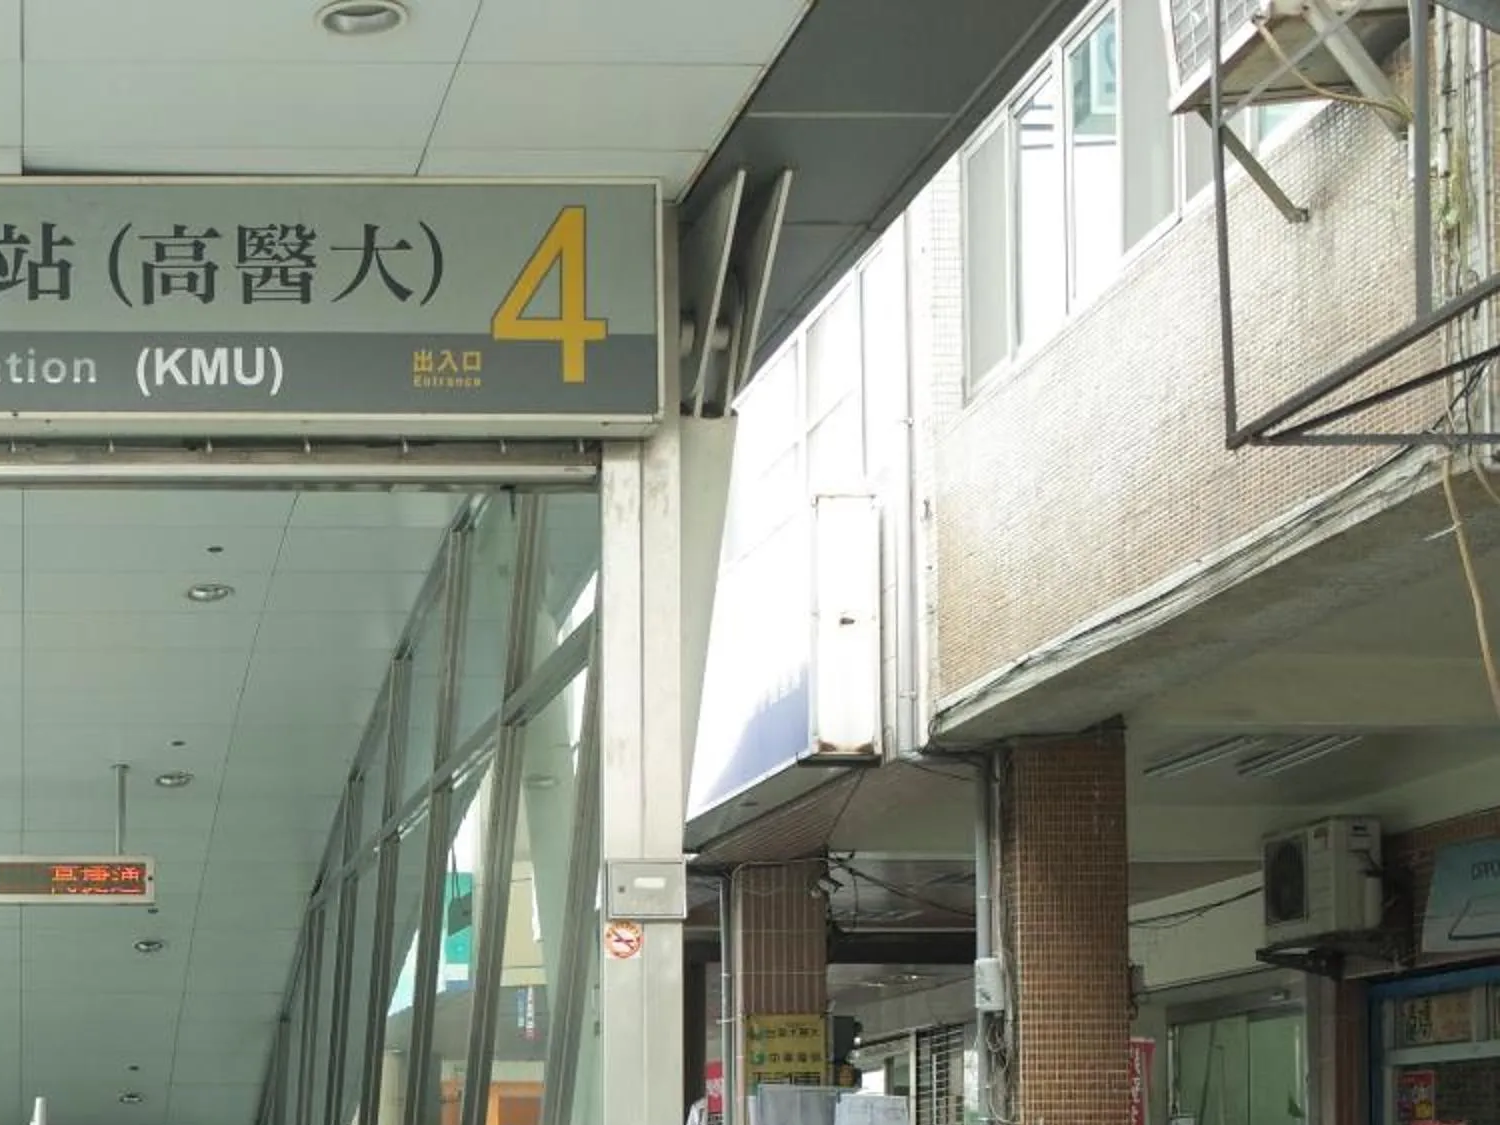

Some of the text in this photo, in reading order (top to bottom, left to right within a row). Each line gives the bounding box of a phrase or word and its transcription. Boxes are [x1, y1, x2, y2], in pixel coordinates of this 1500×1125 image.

[490, 204, 609, 384] 4
[135, 346, 284, 397] (KMU)
[412, 349, 482, 373] 出入口
[412, 374, 482, 388] Entrance
